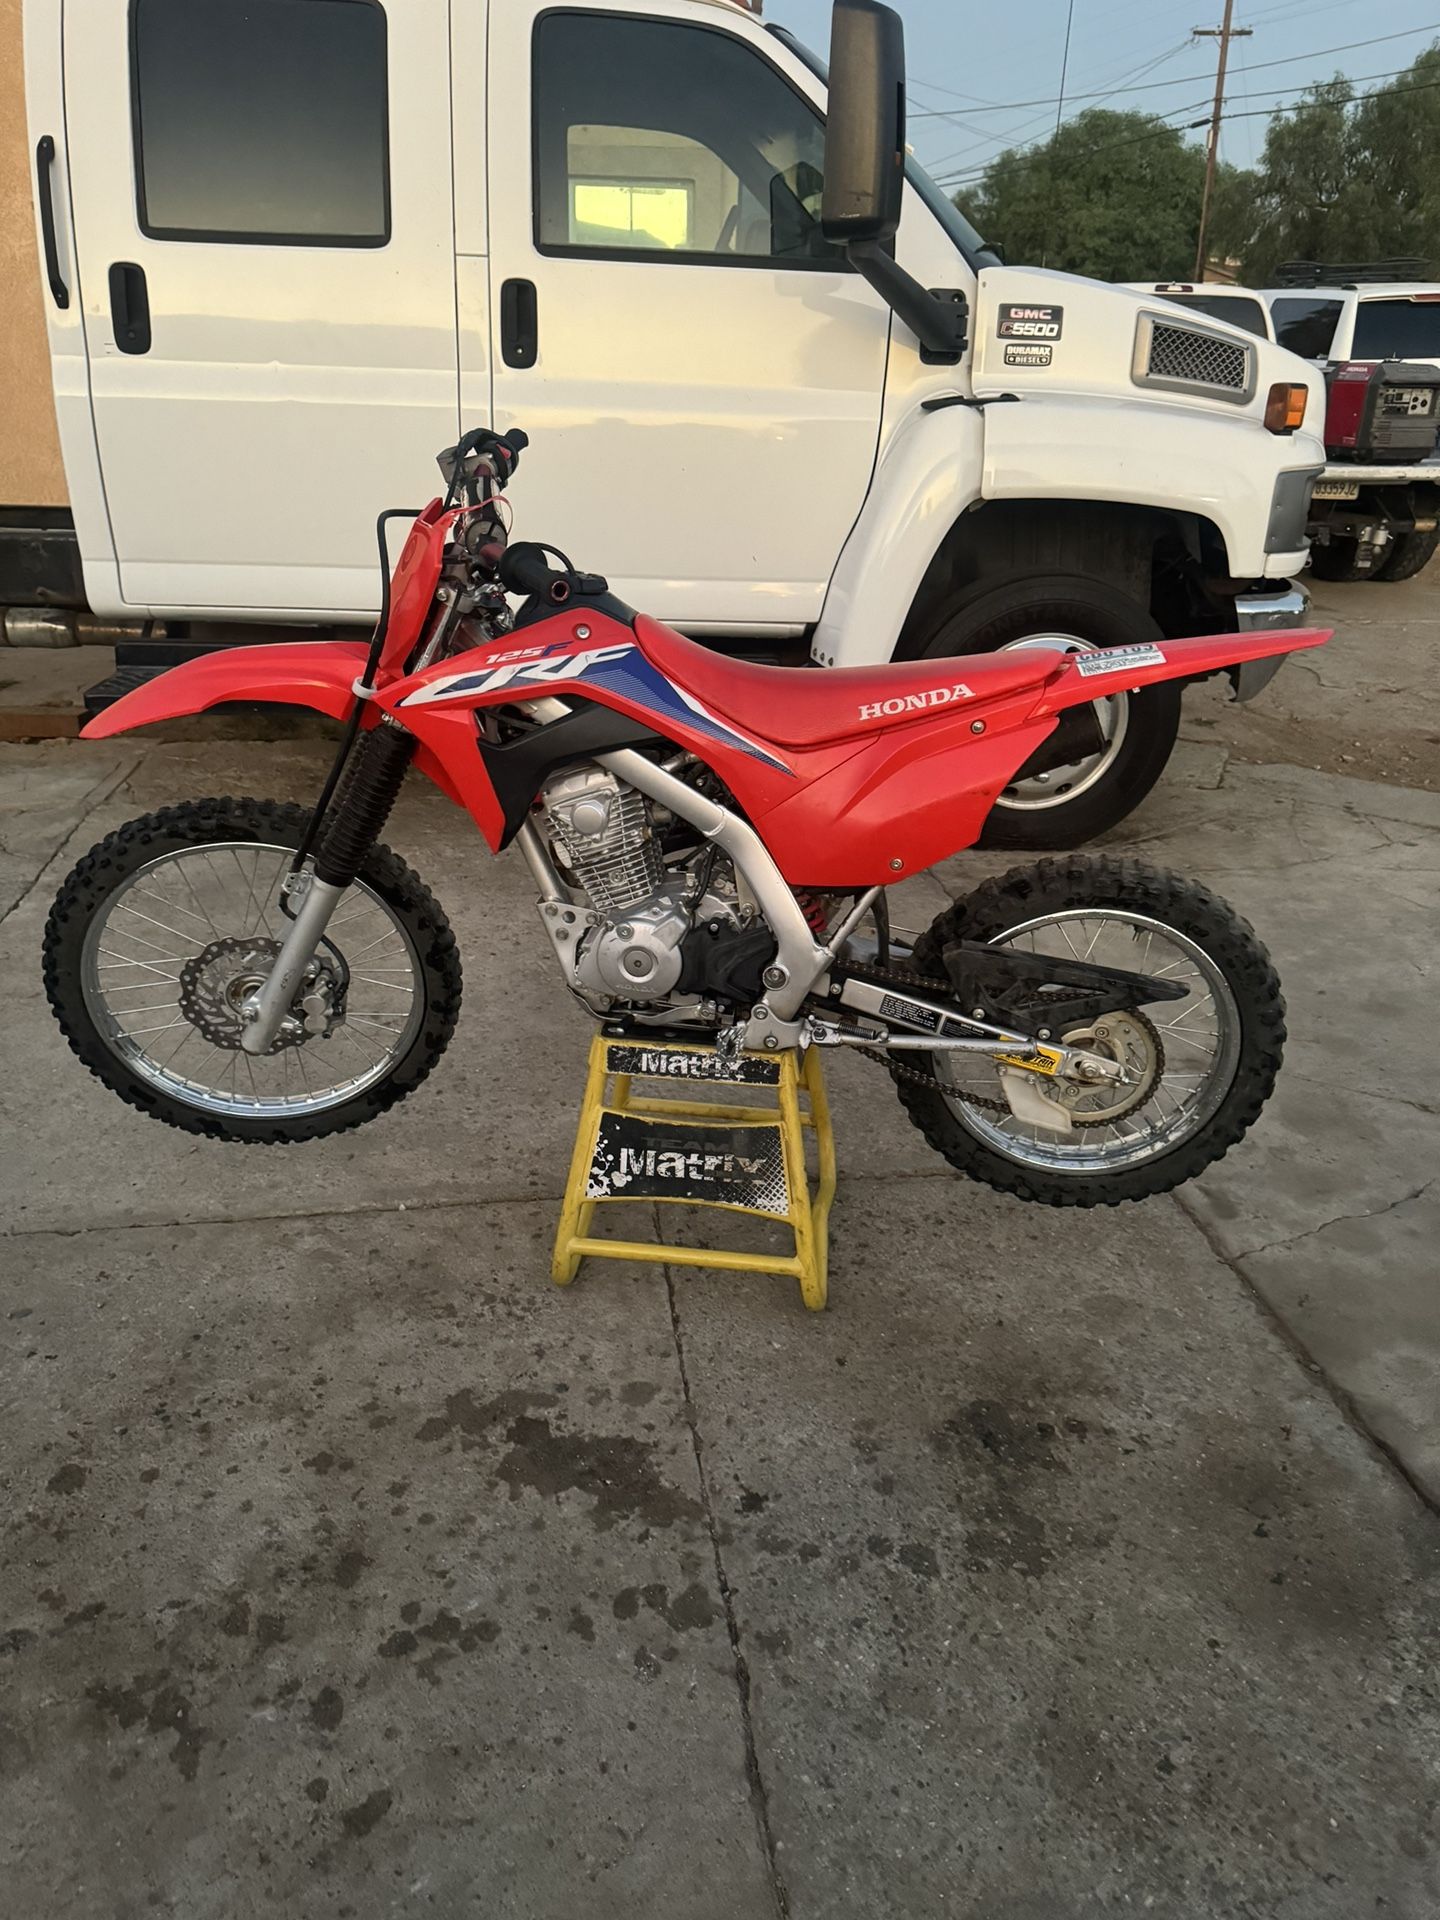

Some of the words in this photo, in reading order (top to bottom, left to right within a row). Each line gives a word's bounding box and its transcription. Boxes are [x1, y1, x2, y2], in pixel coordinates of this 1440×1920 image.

[1010, 308, 1052, 319] GMC
[1000, 322, 1059, 336] C5500
[1007, 346, 1051, 355] DURAMAX
[1015, 355, 1040, 363] DIESEL
[486, 641, 574, 664] 125F
[400, 643, 636, 707] CRF
[858, 683, 976, 720] HONDA
